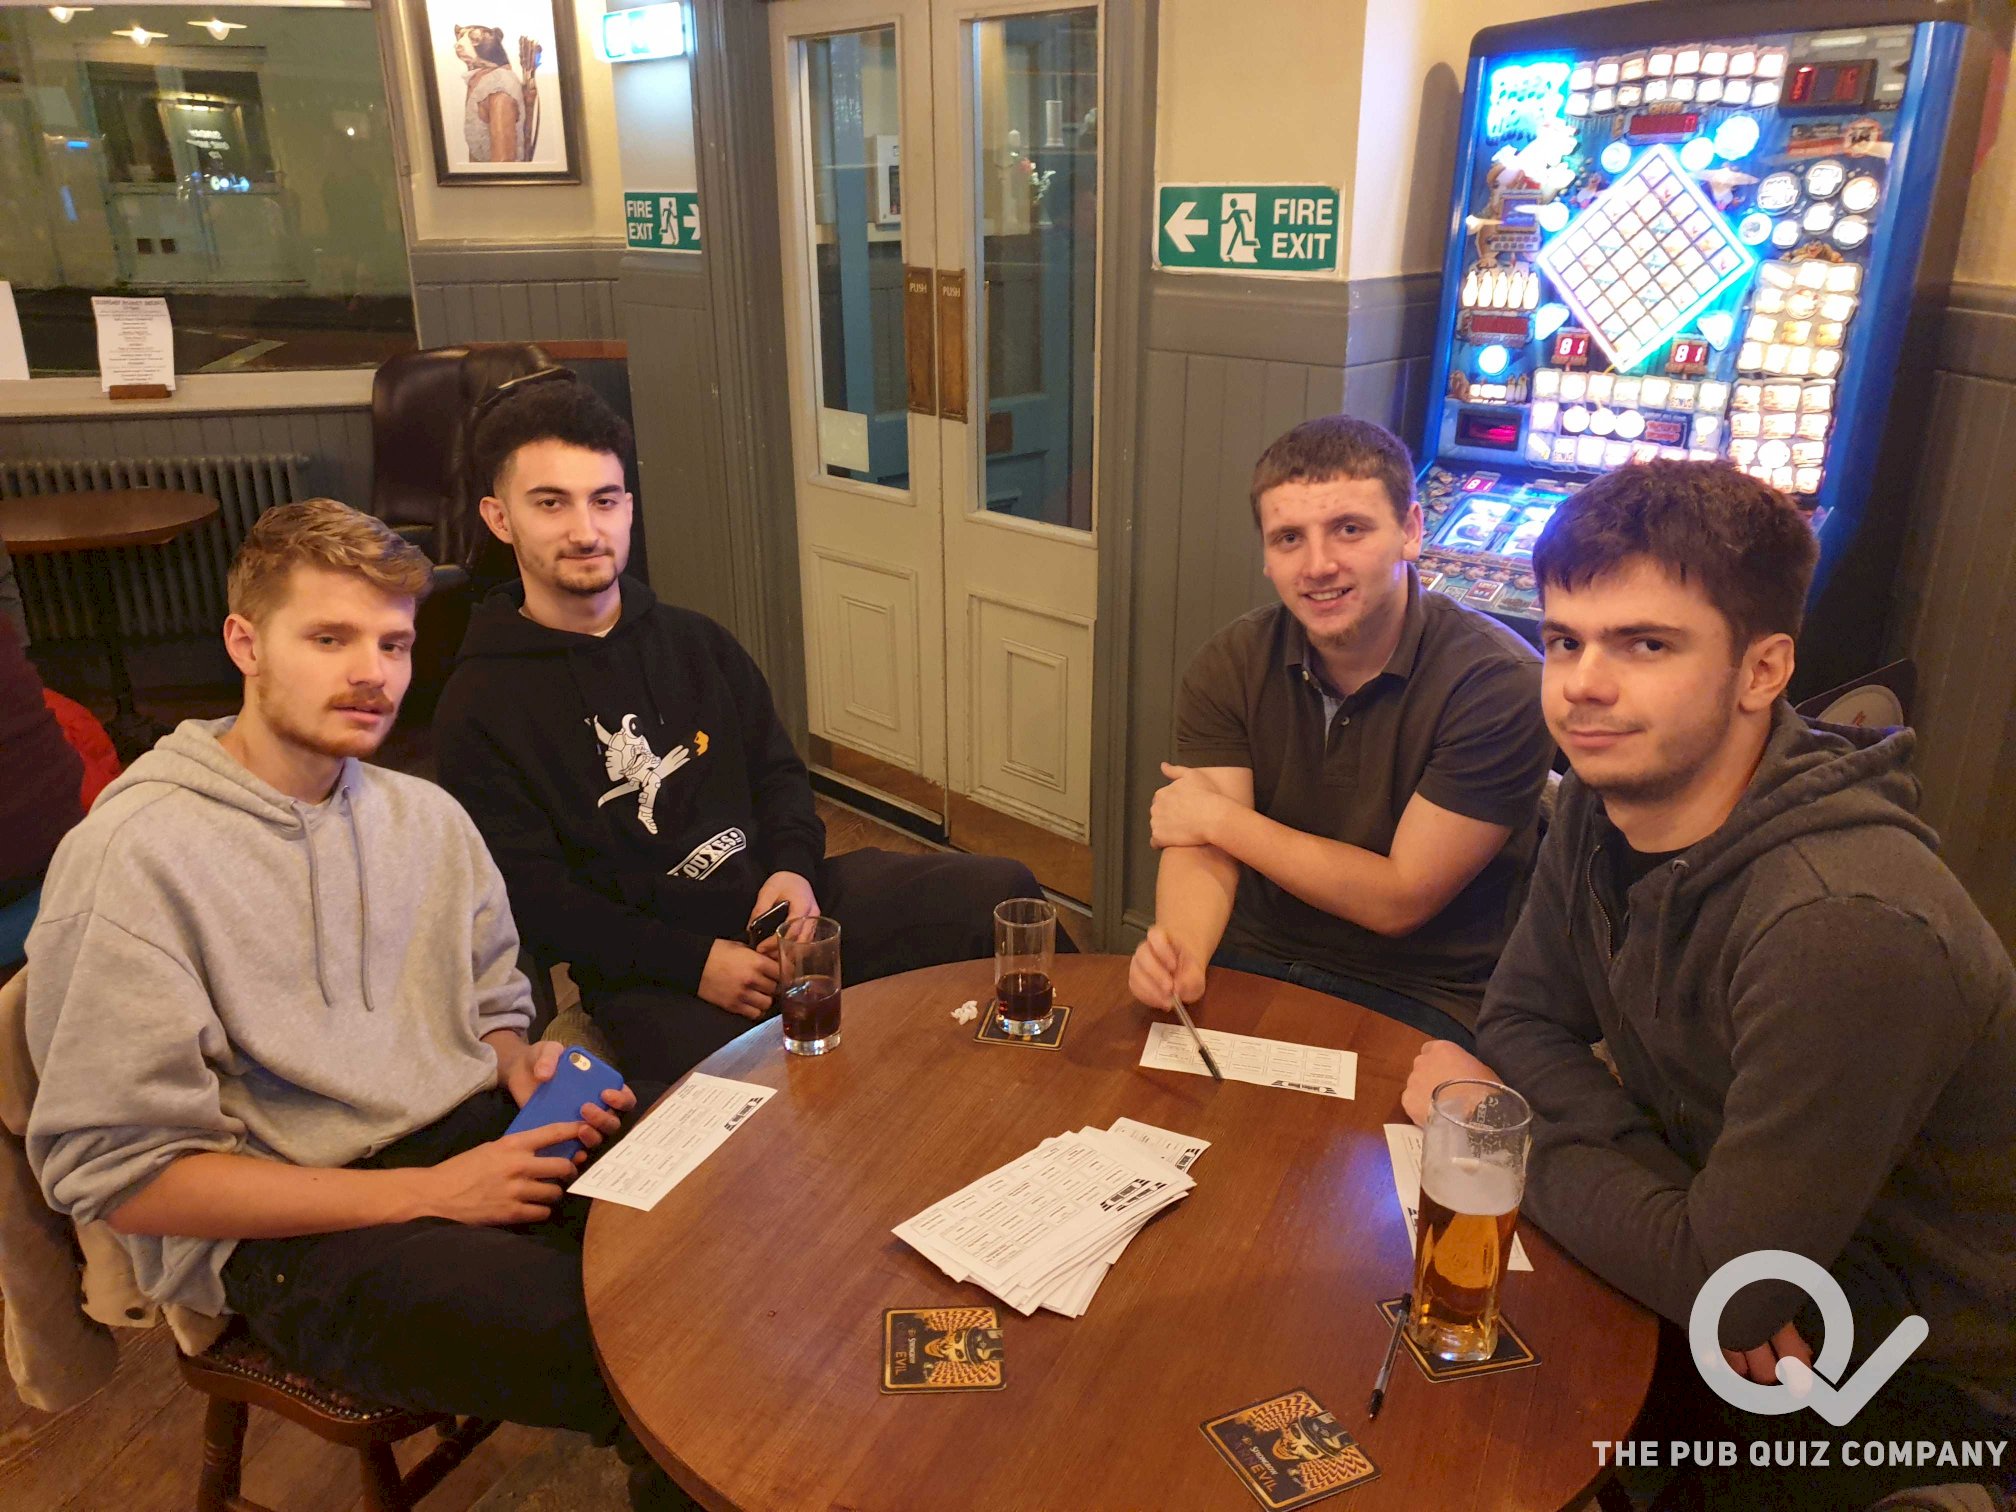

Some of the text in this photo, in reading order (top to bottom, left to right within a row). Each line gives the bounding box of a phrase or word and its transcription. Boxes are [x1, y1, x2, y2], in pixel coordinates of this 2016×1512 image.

[627, 200, 653, 218] FIRE
[1273, 198, 1333, 226] FIRE
[628, 222, 654, 240] EXIT
[1272, 232, 1331, 259] EXIT
[909, 282, 927, 294] PUSH
[942, 286, 961, 298] PUSH
[895, 1351, 907, 1375] EVIL
[1250, 1464, 1278, 1492] EVIL
